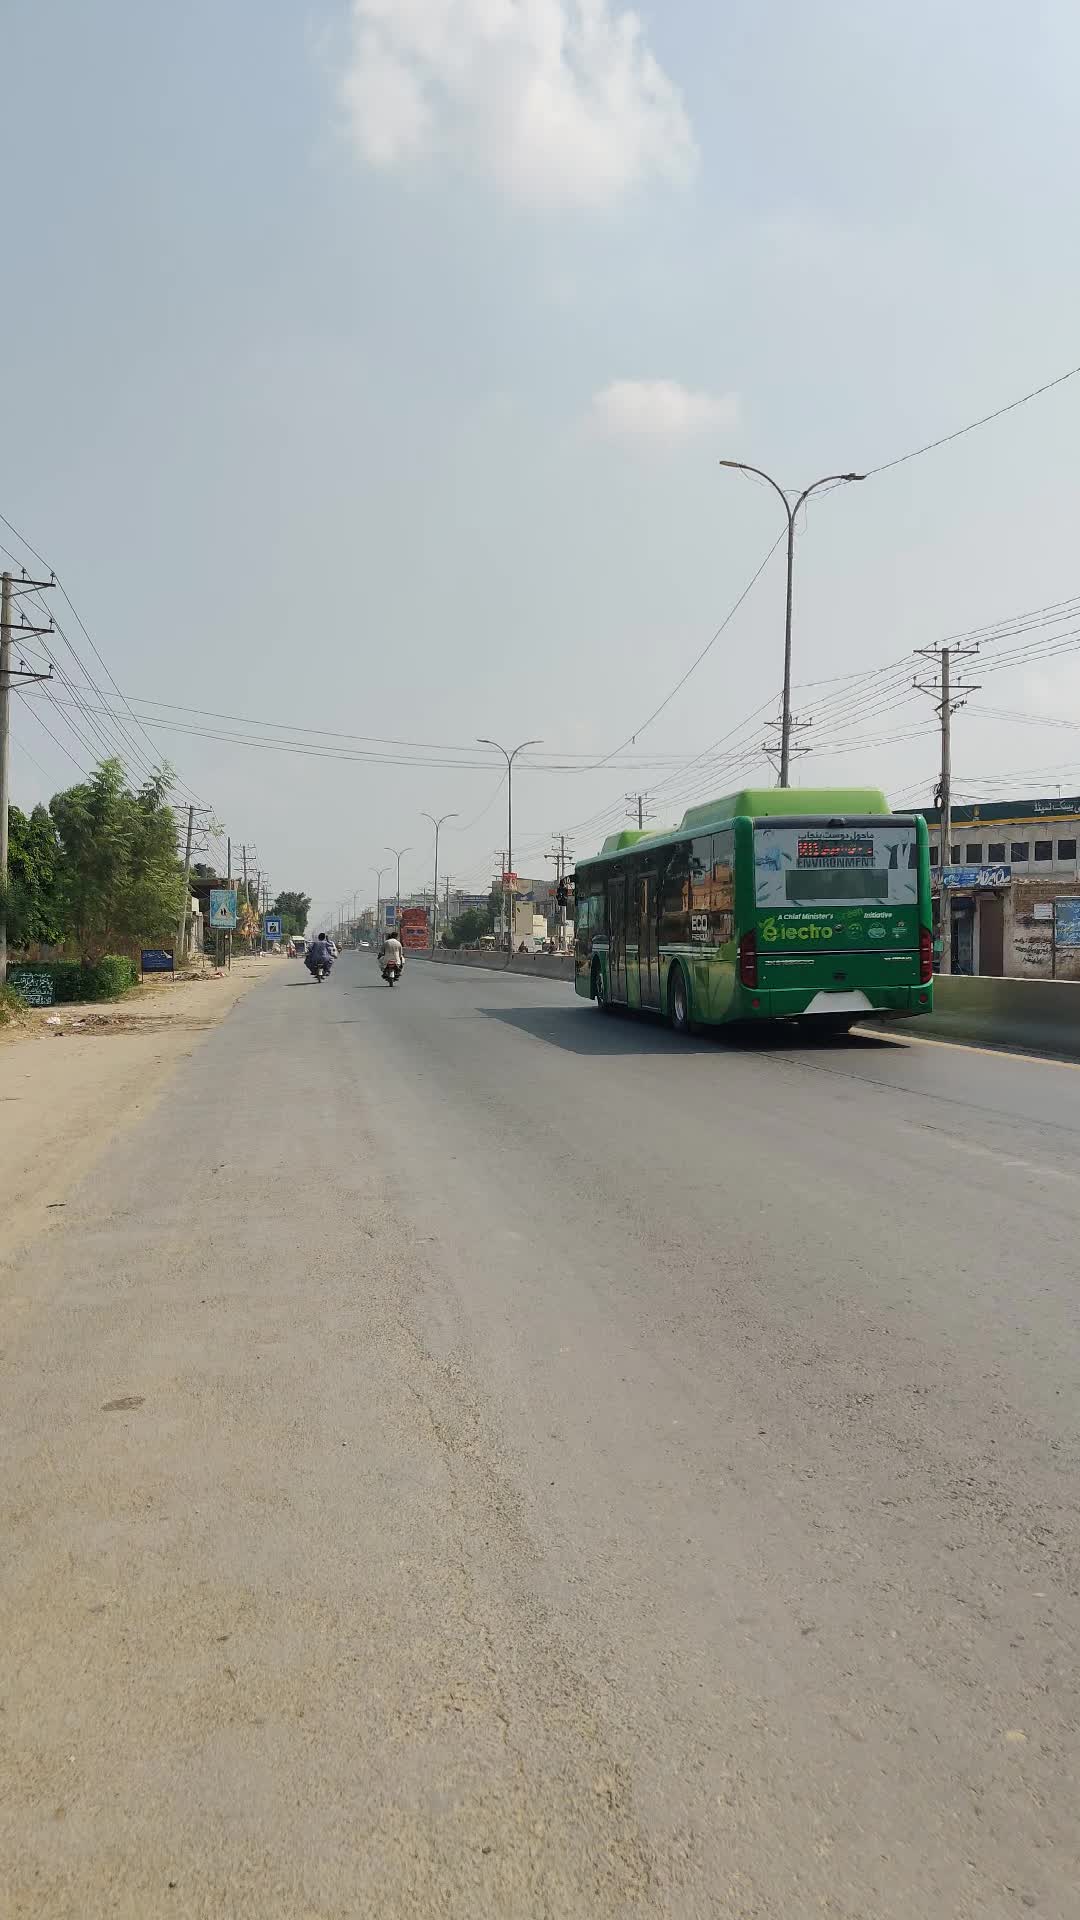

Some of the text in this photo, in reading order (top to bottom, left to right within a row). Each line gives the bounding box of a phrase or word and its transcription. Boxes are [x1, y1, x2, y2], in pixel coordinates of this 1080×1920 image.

[798, 832, 874, 841] ماحول دوست پنجاب
[797, 857, 875, 868] ENVIRONMENT
[691, 915, 707, 931] ECO
